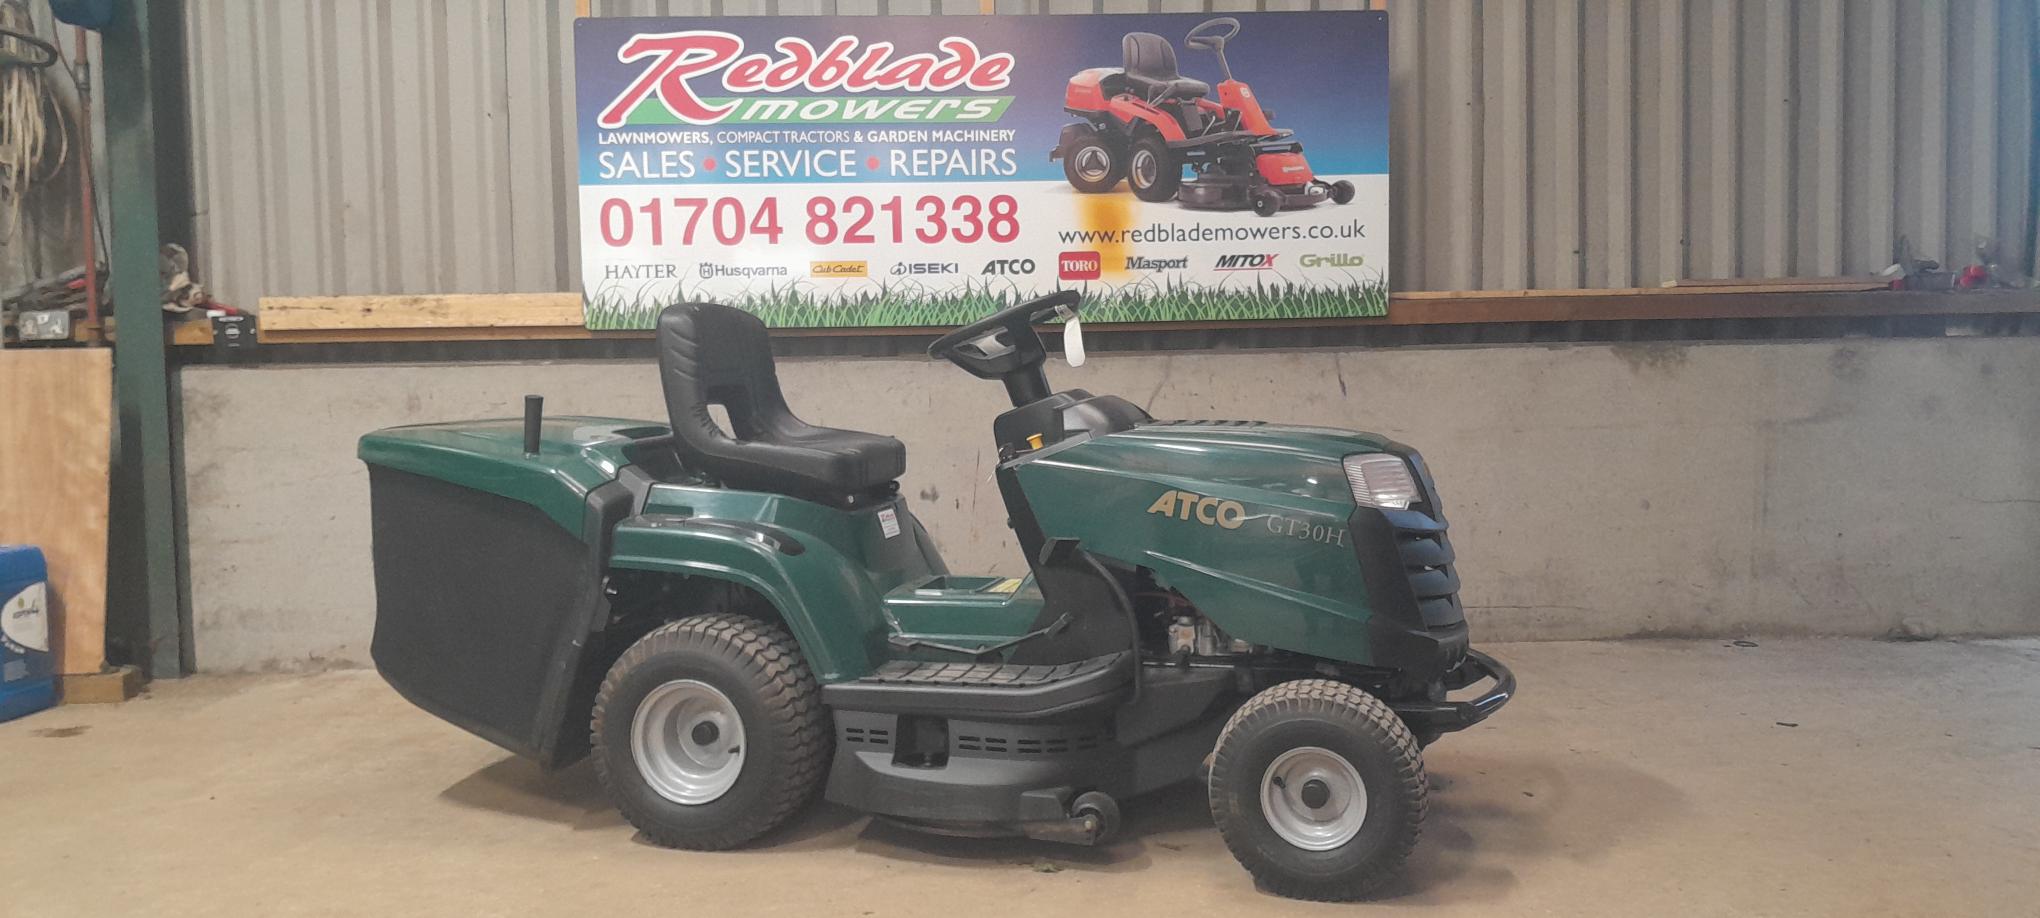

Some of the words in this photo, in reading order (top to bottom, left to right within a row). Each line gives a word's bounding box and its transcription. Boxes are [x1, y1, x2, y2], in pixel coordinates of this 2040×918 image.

[598, 30, 1015, 128] Redblade
[741, 98, 1000, 121] mowers
[598, 131, 714, 146] LAWNMOWERS,
[716, 131, 781, 145] COMPACT
[782, 130, 850, 144] TRACTORS
[853, 130, 864, 143] &
[867, 130, 928, 143] GARDEN
[932, 129, 1016, 143] MACHINERY
[599, 151, 696, 179] SALES
[725, 150, 857, 178] SERVICE
[890, 148, 1017, 176] REPAIRS
[600, 197, 783, 247] 01704
[805, 194, 1021, 245] 821338
[1058, 219, 1366, 244] www.redblademowers.co.uk
[812, 264, 832, 274] Cub
[832, 263, 865, 274] Cadet
[909, 262, 959, 275] ISEKI
[981, 258, 1036, 276] ATCO
[1061, 259, 1098, 272] TORO
[1124, 255, 1189, 273] Masport
[1214, 253, 1279, 268] MITOX
[1299, 253, 1364, 268] Grillo
[605, 264, 678, 280] HAYTER
[714, 264, 788, 281] Husqvarna
[1147, 489, 1246, 530] ATCO
[1266, 514, 1345, 548] GT30H
